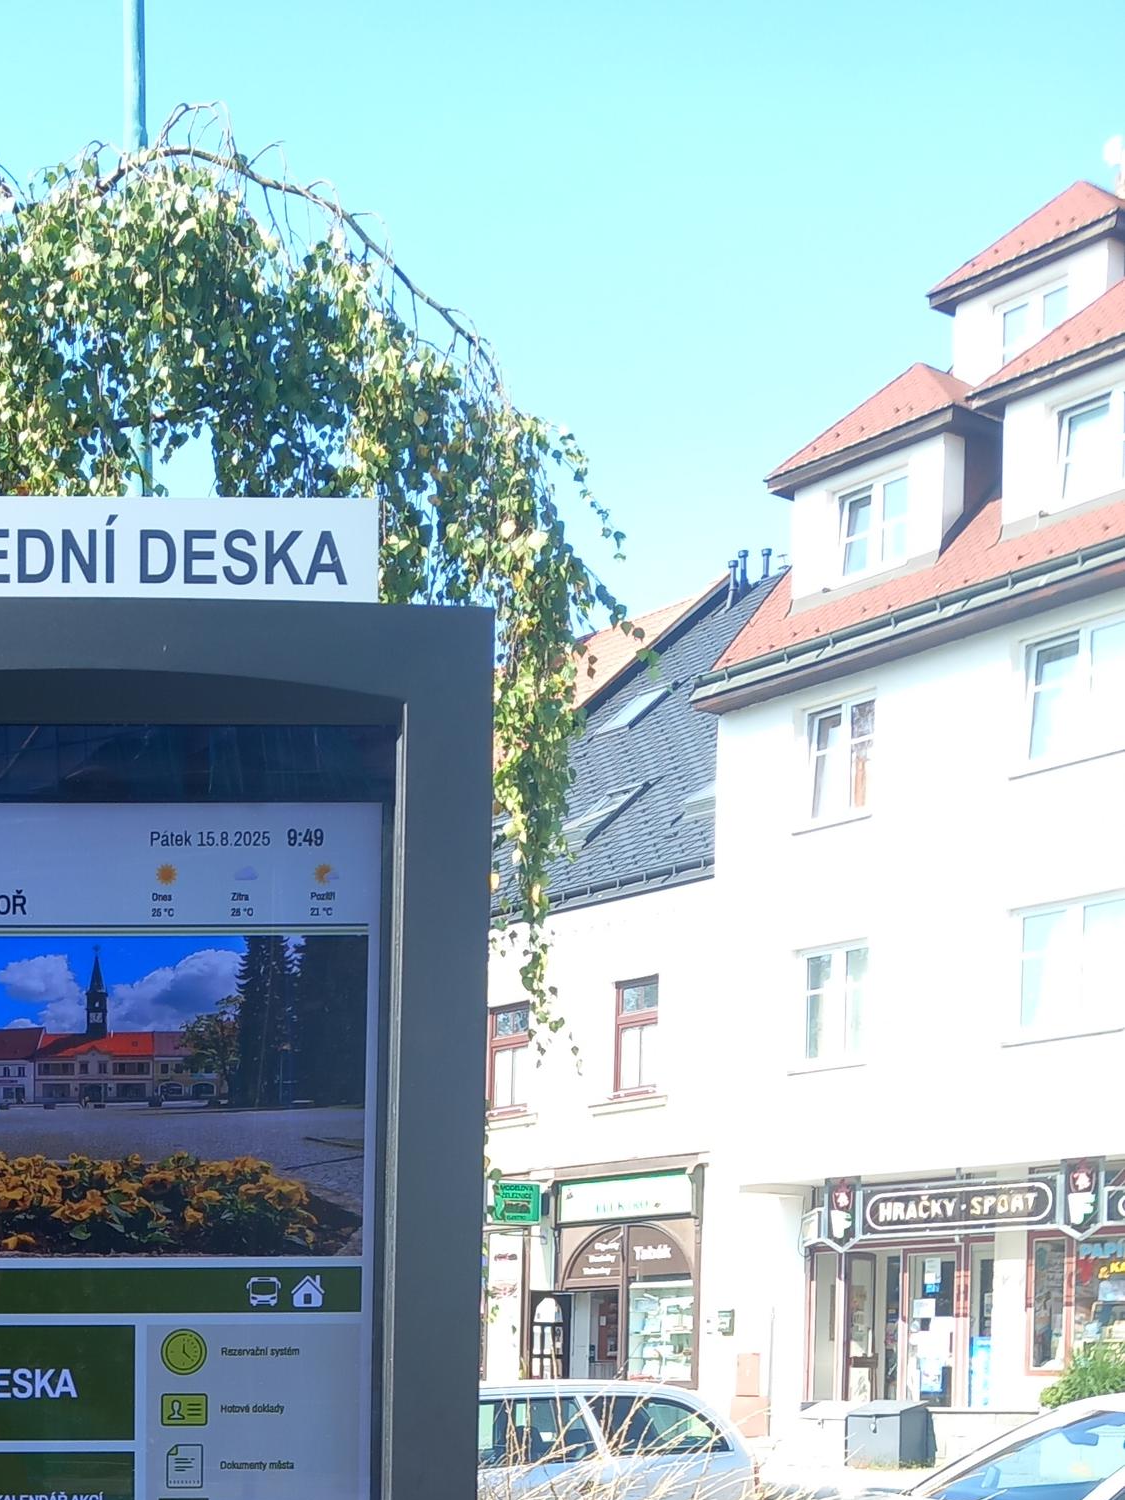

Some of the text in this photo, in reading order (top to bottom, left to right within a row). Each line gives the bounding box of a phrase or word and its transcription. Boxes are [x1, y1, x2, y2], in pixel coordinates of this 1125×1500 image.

[139, 528, 348, 586] DESKA
[150, 828, 324, 847] Pátek 15.8.2025 9:49
[151, 892, 172, 902] Dnes
[878, 1190, 1038, 1223] HRAČKY SPORT
[221, 1346, 300, 1358] Rezervační systém
[220, 1403, 285, 1415] Hotové doklady
[220, 1461, 295, 1471] Dokumenty města
